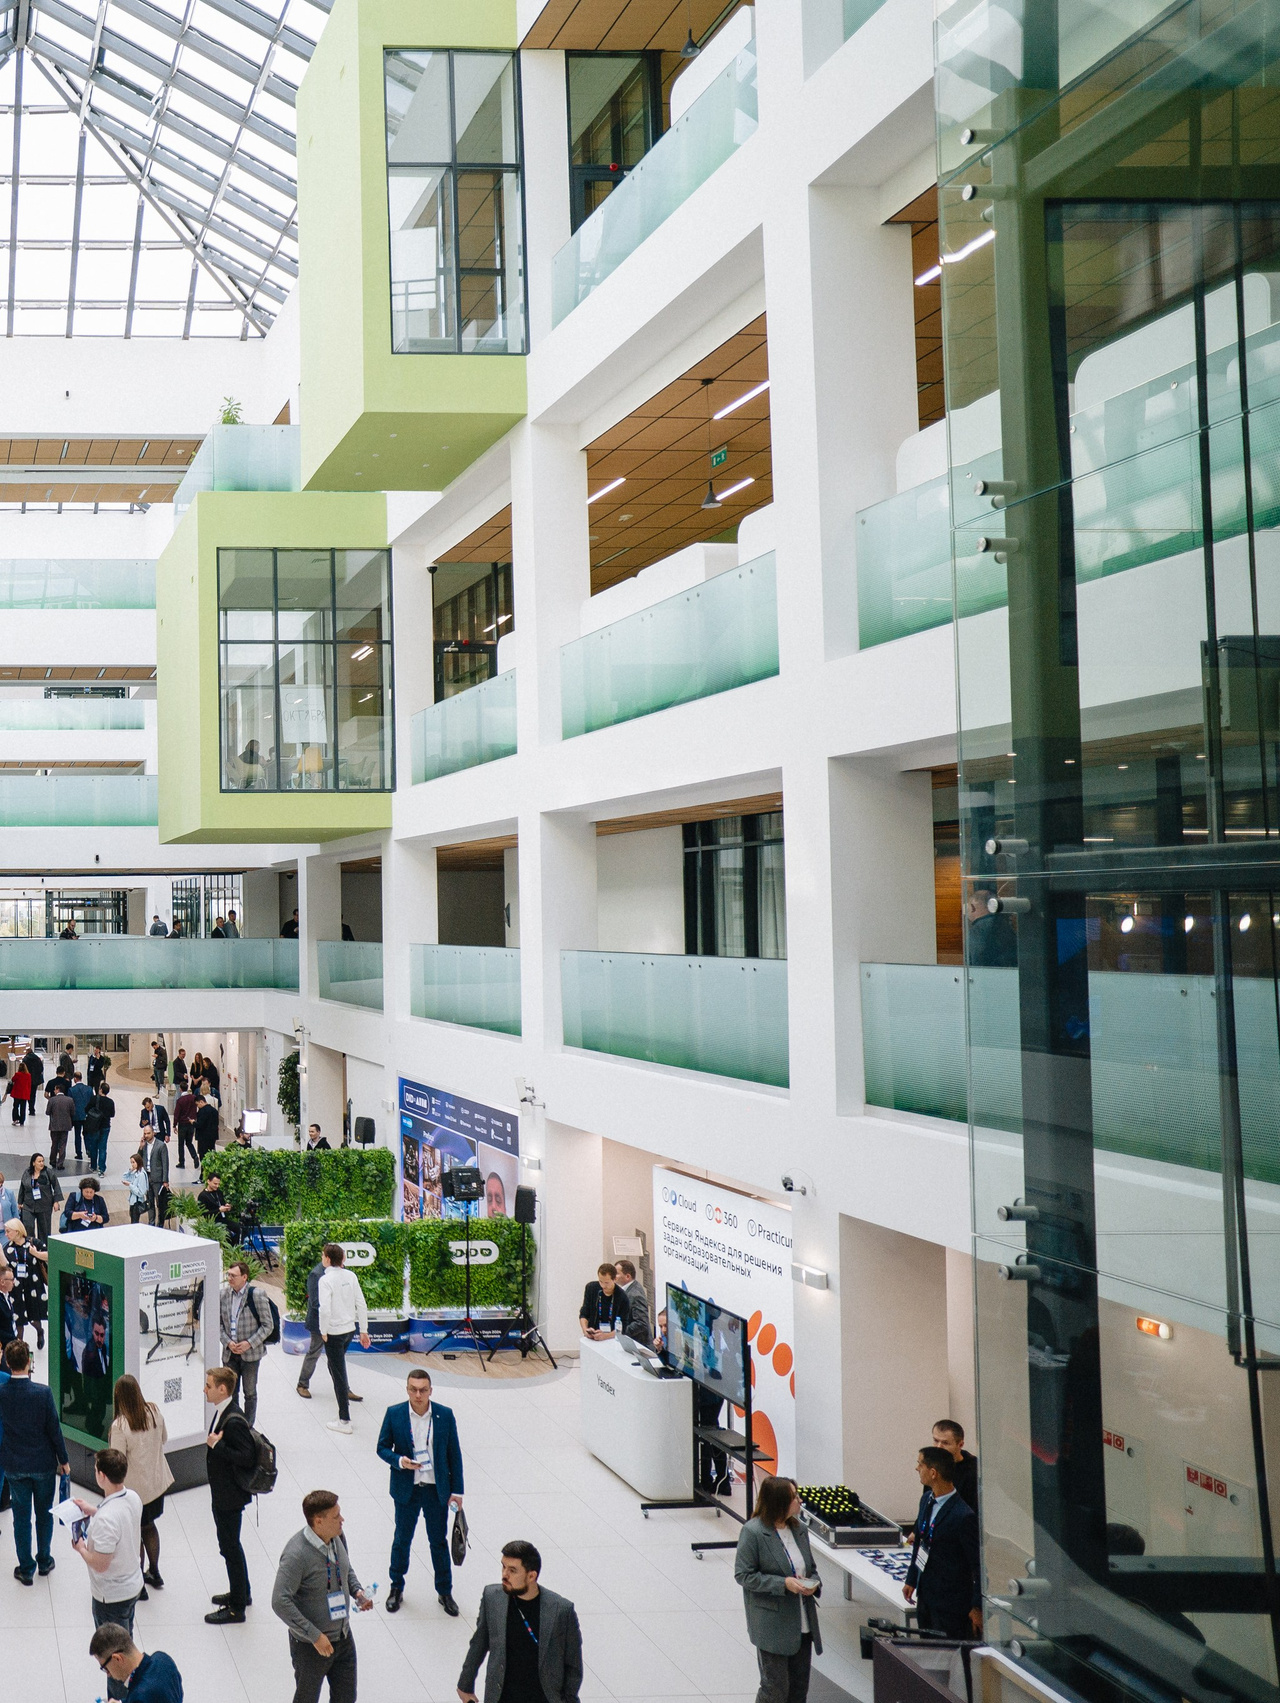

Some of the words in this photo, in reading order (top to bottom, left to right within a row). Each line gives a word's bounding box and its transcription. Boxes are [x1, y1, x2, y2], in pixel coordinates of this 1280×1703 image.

[678, 1194, 697, 1212] Cloud
[723, 1211, 738, 1229] 360
[663, 1216, 693, 1239] Сервисы
[695, 1229, 726, 1253] Яндекса
[727, 1246, 743, 1260] для
[744, 1252, 783, 1277] решения
[663, 1231, 682, 1247] задач
[684, 1240, 751, 1279] образовательных
[663, 1245, 709, 1274] организаций
